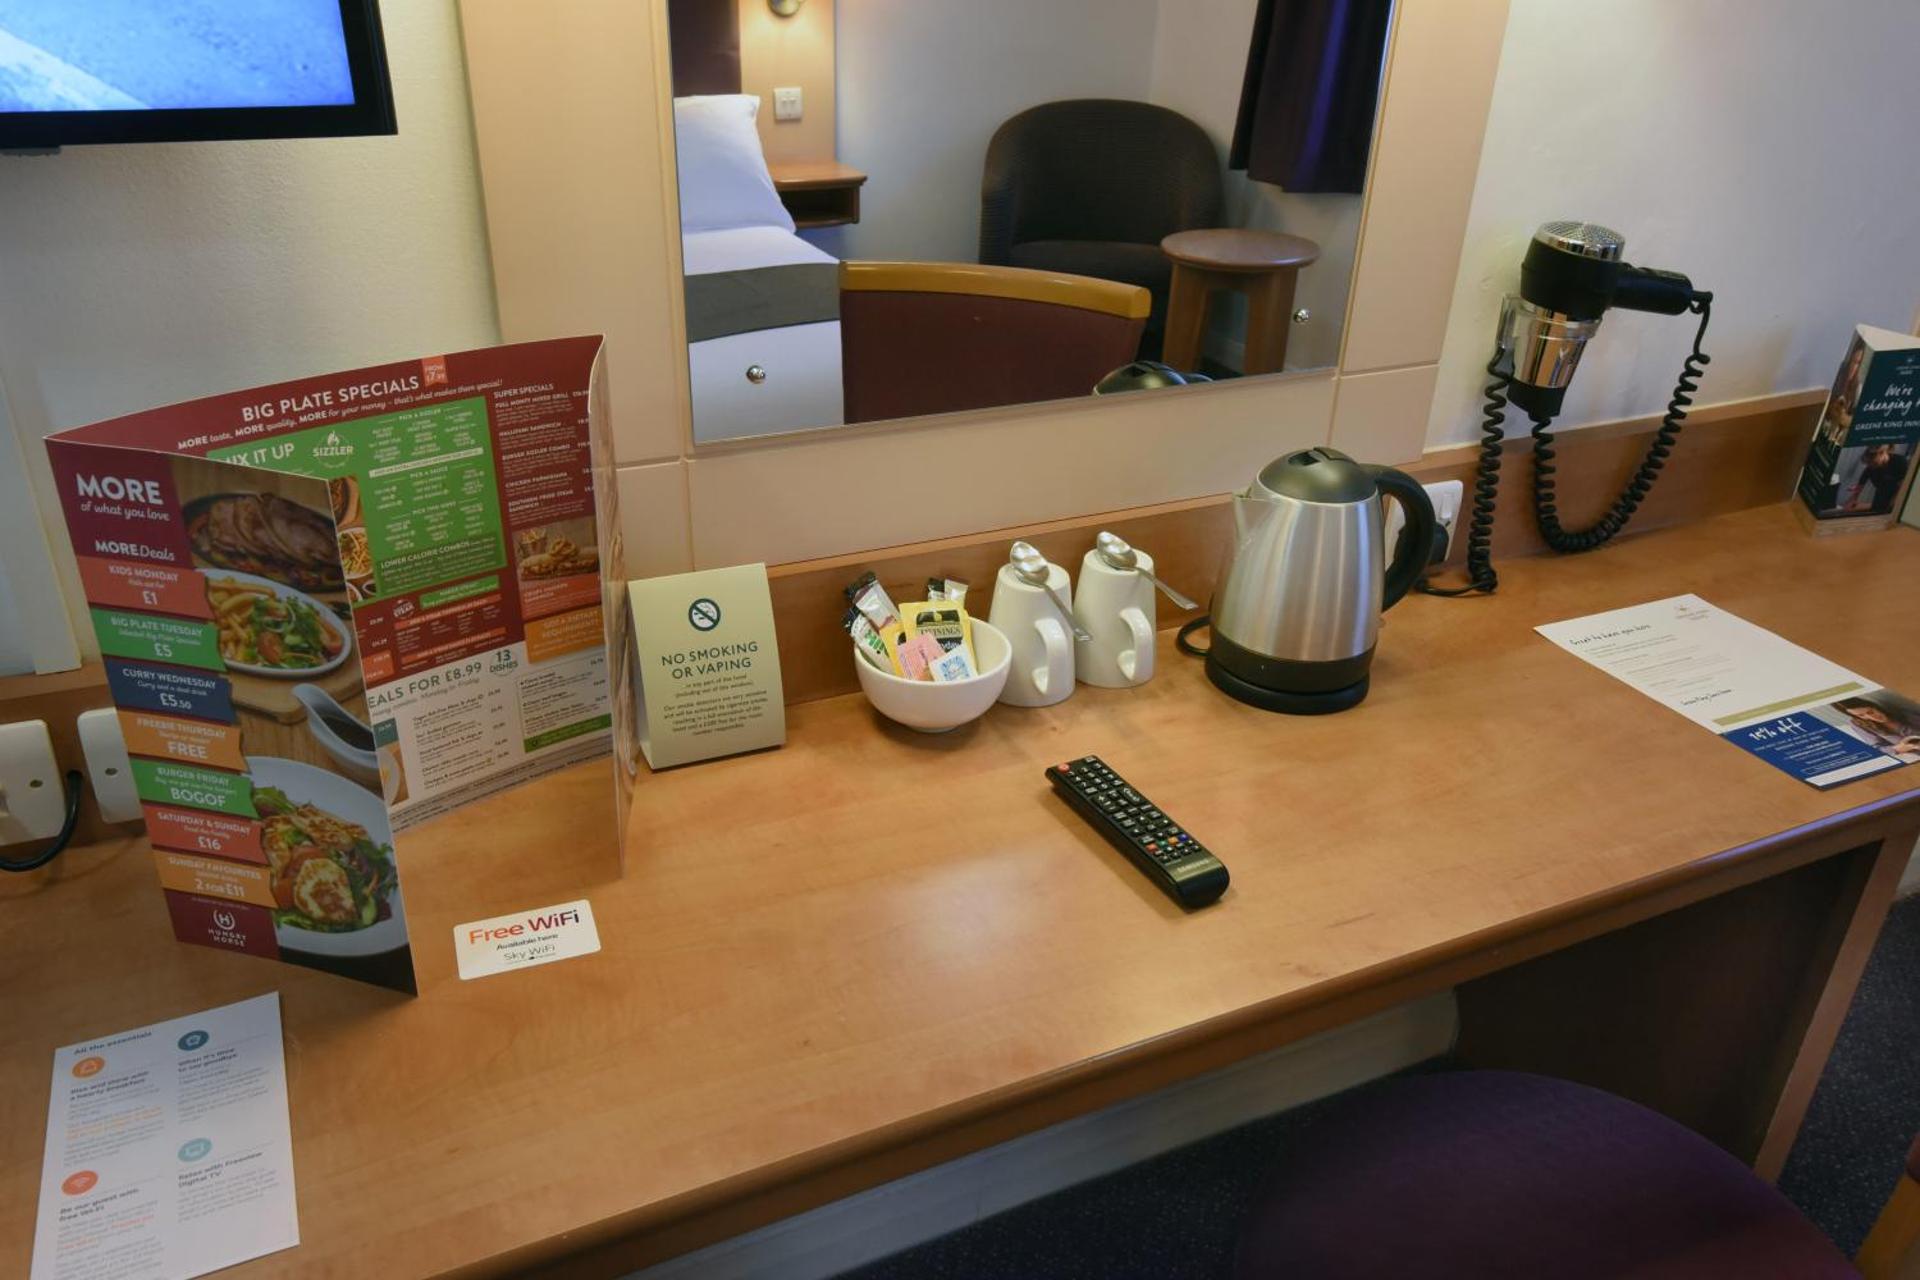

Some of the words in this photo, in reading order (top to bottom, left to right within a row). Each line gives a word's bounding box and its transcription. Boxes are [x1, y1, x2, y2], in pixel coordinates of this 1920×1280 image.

[242, 403, 274, 422] BIG
[280, 391, 334, 414] PLATE
[338, 376, 420, 402] SPECIALS
[494, 388, 519, 398] SUPER
[519, 384, 554, 394] SPECIALS
[1885, 384, 1912, 397] We're
[1864, 400, 1912, 416] changing
[178, 434, 208, 450] MORE
[235, 423, 264, 436] MORE
[299, 410, 327, 423] MORE
[328, 408, 339, 417] for
[342, 405, 359, 417] your
[361, 402, 386, 412] money
[415, 392, 433, 400] what
[434, 388, 457, 398] makes
[458, 385, 475, 394] them
[1855, 422, 1882, 430] GREENE
[1884, 420, 1903, 429] KING
[226, 452, 250, 466] IX
[254, 449, 267, 464] IT
[272, 443, 295, 460] UP
[312, 445, 354, 458] SIZZLER
[76, 473, 164, 505] MORE
[81, 501, 90, 512] of
[94, 503, 122, 516] what
[124, 508, 144, 520] you
[146, 509, 170, 522] love
[381, 558, 406, 568] LOWER
[408, 550, 438, 562] CALORIE
[108, 565, 132, 576] KIDS
[134, 568, 178, 582] MONDAY
[142, 590, 158, 605] £1
[110, 616, 128, 626] BIG
[130, 618, 158, 632] PLATE
[160, 623, 203, 637] TUESDAY
[154, 642, 172, 658] £5
[496, 649, 512, 662] 13
[662, 653, 686, 666] NO
[689, 641, 758, 662] SMOKING
[490, 660, 519, 673] DISHES
[672, 666, 692, 680] OR
[696, 657, 752, 675] VAPING
[122, 668, 156, 680] CURRY
[156, 673, 216, 690] WEDNESDAY
[138, 680, 156, 690] Curry
[368, 686, 404, 708] EALS
[408, 675, 440, 694] FOR
[445, 662, 482, 682] £8.99
[160, 692, 192, 710] £5.50
[136, 718, 176, 730] FREEBIE
[176, 722, 226, 738] THURSDAY
[1749, 724, 1778, 742] 15%
[1777, 717, 1808, 736] off
[167, 741, 208, 760] FREE
[156, 767, 195, 780] BURGER
[196, 772, 230, 786] FRIDAY
[170, 787, 226, 807] BOGOF
[156, 812, 204, 826] SATURDAY
[205, 820, 212, 828] &
[214, 820, 251, 836] SUNDAY
[197, 836, 222, 850] £16
[168, 856, 206, 869] SUNDAY
[195, 878, 204, 890] 2
[225, 883, 245, 897] £11
[208, 928, 247, 942] HUNGRY
[468, 922, 524, 945] Free
[528, 909, 579, 932] WiFi
[212, 934, 245, 948] HORSE
[496, 938, 536, 950] Available
[504, 950, 526, 961] Sky
[529, 944, 556, 956] WiFi
[107, 1032, 152, 1047] essentials
[178, 1170, 202, 1180] Relax
[204, 1163, 224, 1173] with
[225, 1152, 263, 1166] Freeview
[178, 1175, 208, 1188] Digital
[210, 1171, 222, 1180] TV
[58, 1213, 78, 1222] Free
